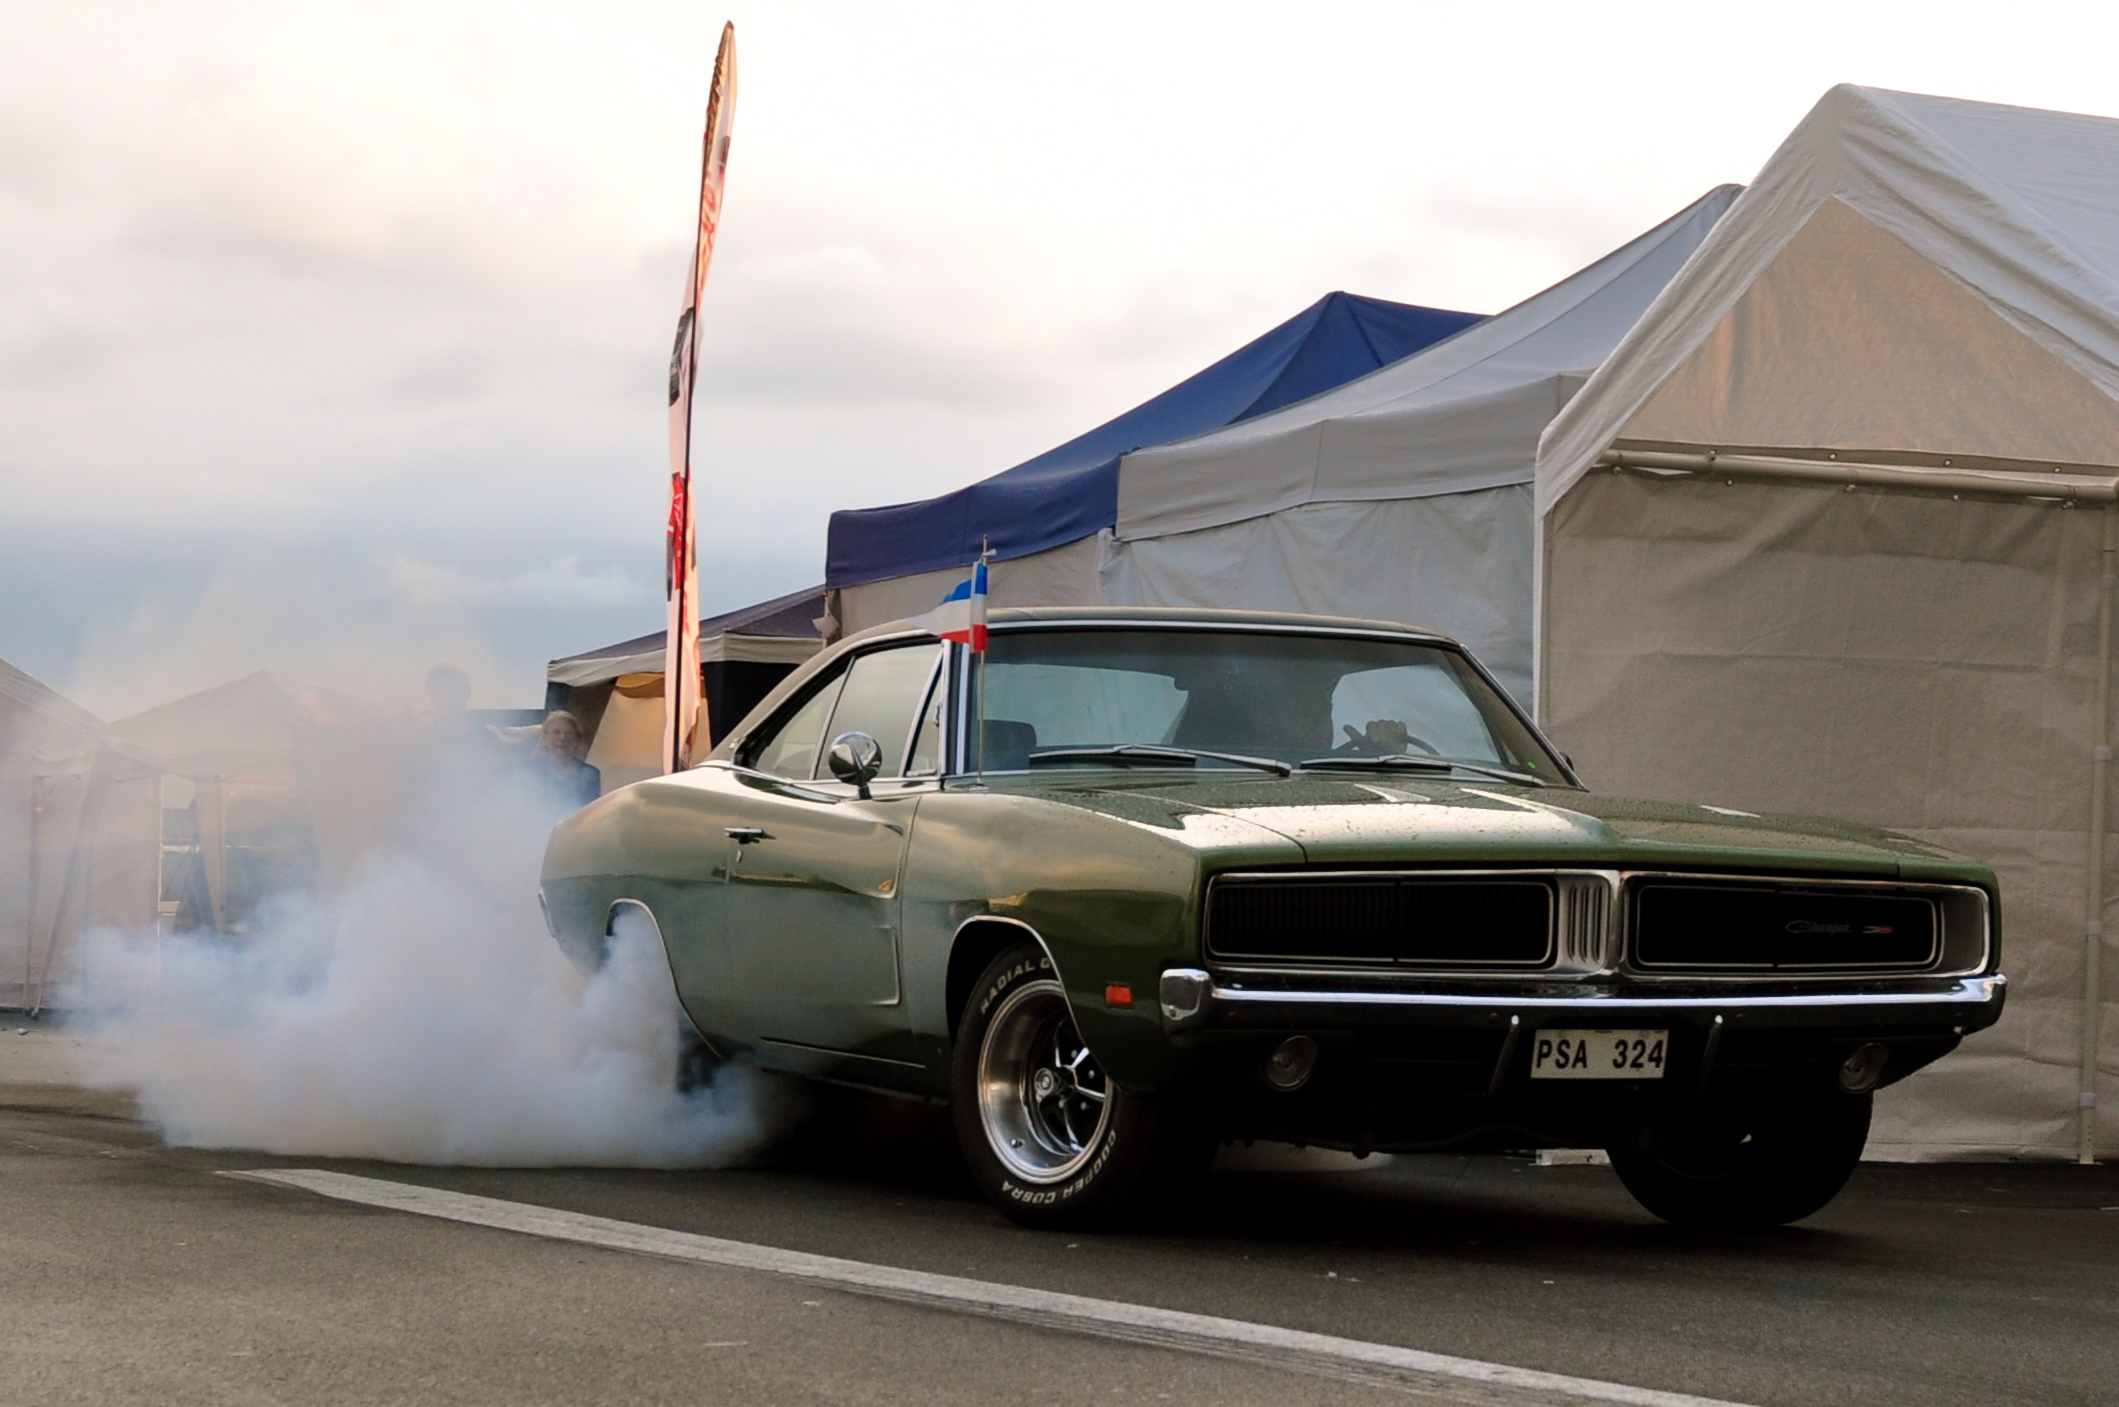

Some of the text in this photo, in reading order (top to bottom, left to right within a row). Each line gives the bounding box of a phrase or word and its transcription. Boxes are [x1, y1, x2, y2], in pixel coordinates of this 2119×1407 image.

[981, 960, 1035, 1014] RADIAL
[1536, 1038, 1663, 1069] PSA 324
[1001, 1129, 1116, 1204] COOPER COBRA
